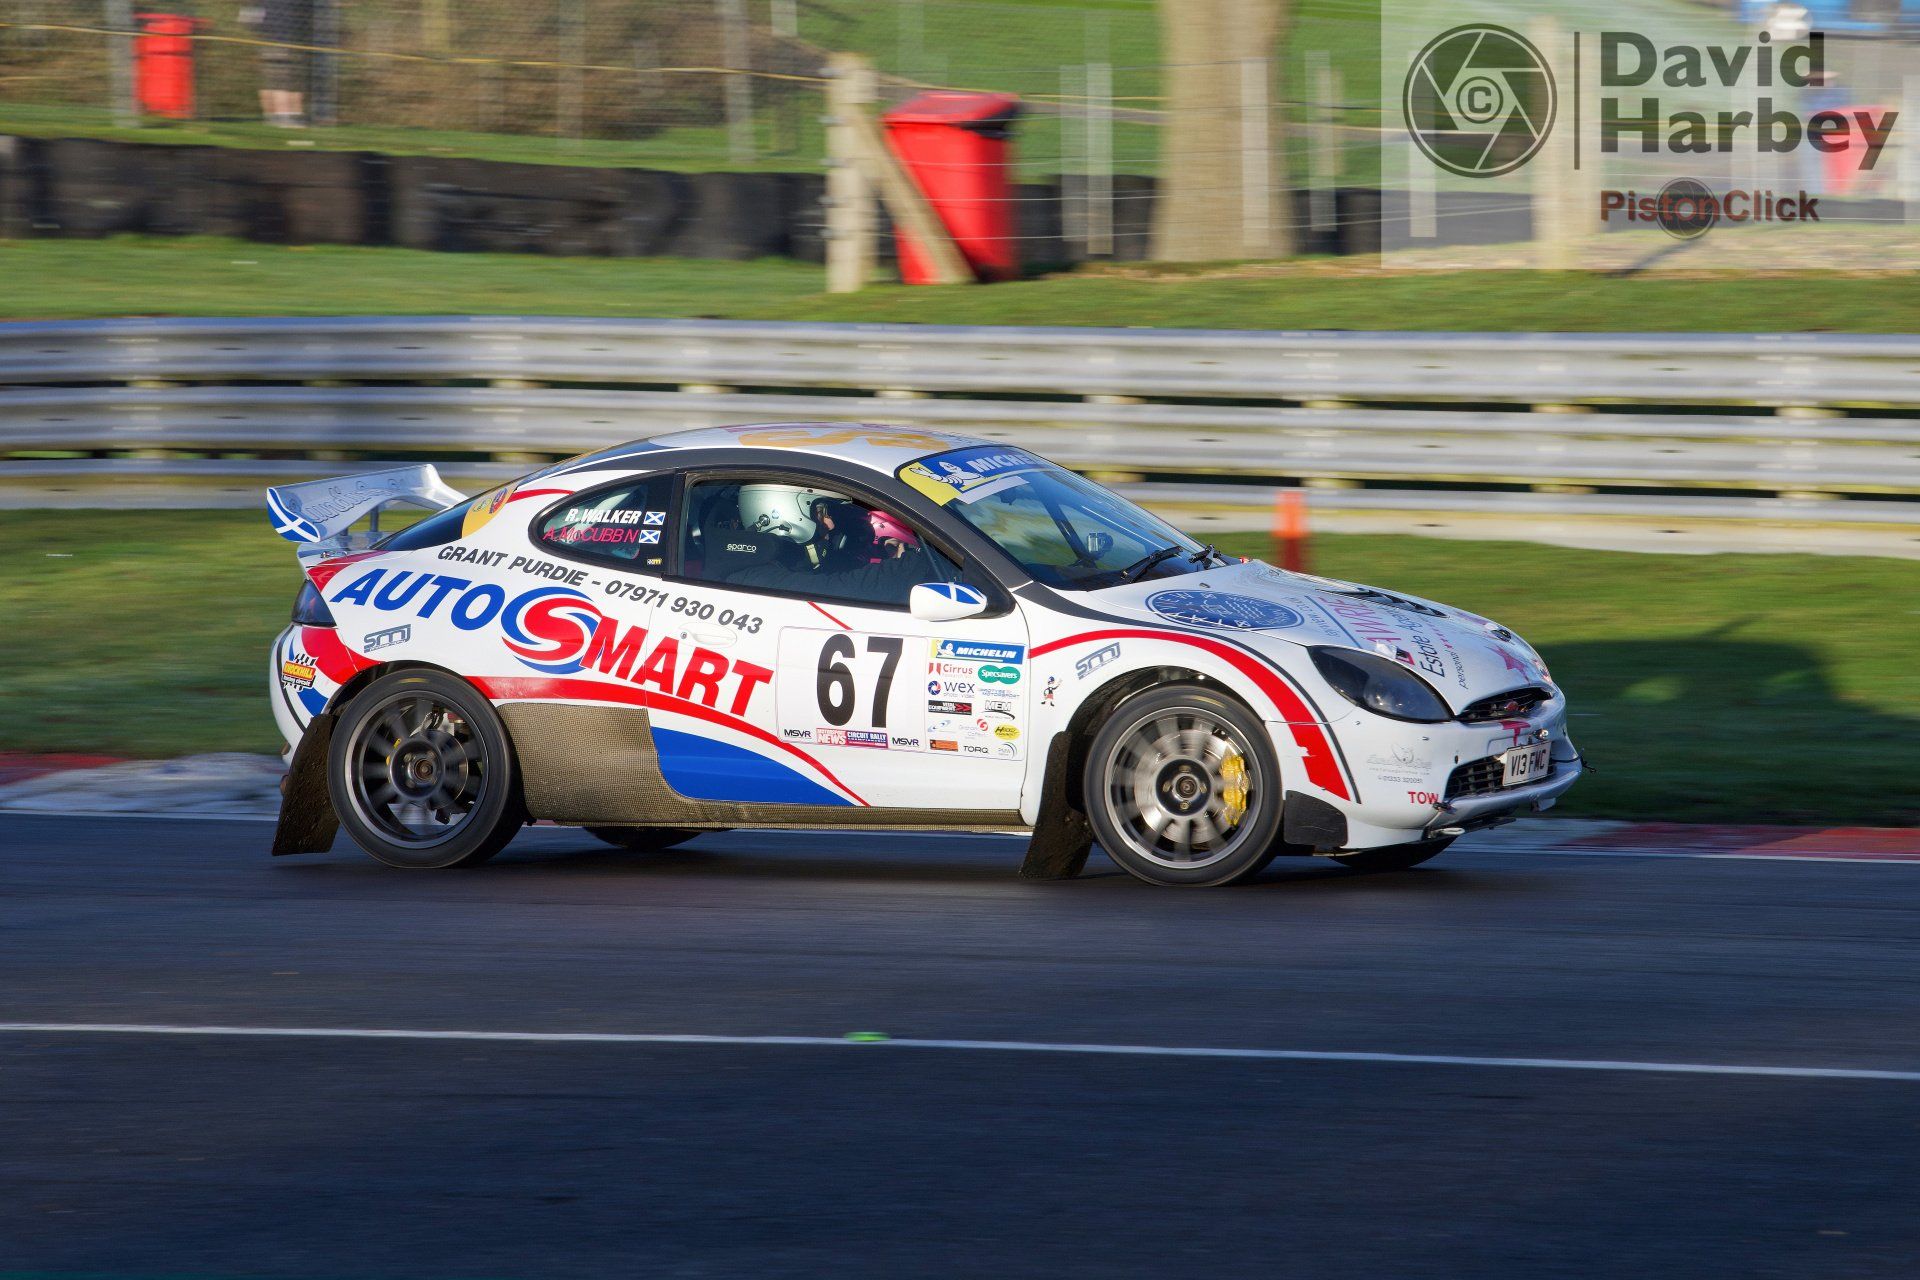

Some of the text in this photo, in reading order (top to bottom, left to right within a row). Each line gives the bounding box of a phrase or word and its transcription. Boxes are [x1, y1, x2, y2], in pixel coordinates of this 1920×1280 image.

[726, 543, 757, 552] sparco
[438, 546, 508, 567] GRANT
[509, 556, 588, 586] PURDIE
[605, 580, 669, 608] 07971
[670, 597, 715, 620] 930
[718, 609, 763, 634] 043
[956, 647, 1017, 658] MICHELIN
[1411, 635, 1445, 678] Estate
[943, 664, 973, 675] Cirrus
[982, 669, 1018, 679] Specsavers
[817, 633, 904, 728] 67
[944, 682, 975, 693] wex
[985, 700, 1012, 712] MEM
[784, 729, 811, 737] MSVR
[818, 734, 846, 745] NEWS
[892, 737, 919, 746] MSVR
[964, 745, 989, 753] TORQ
[1511, 750, 1546, 776] V13 FMC
[1408, 791, 1439, 805] TOW
